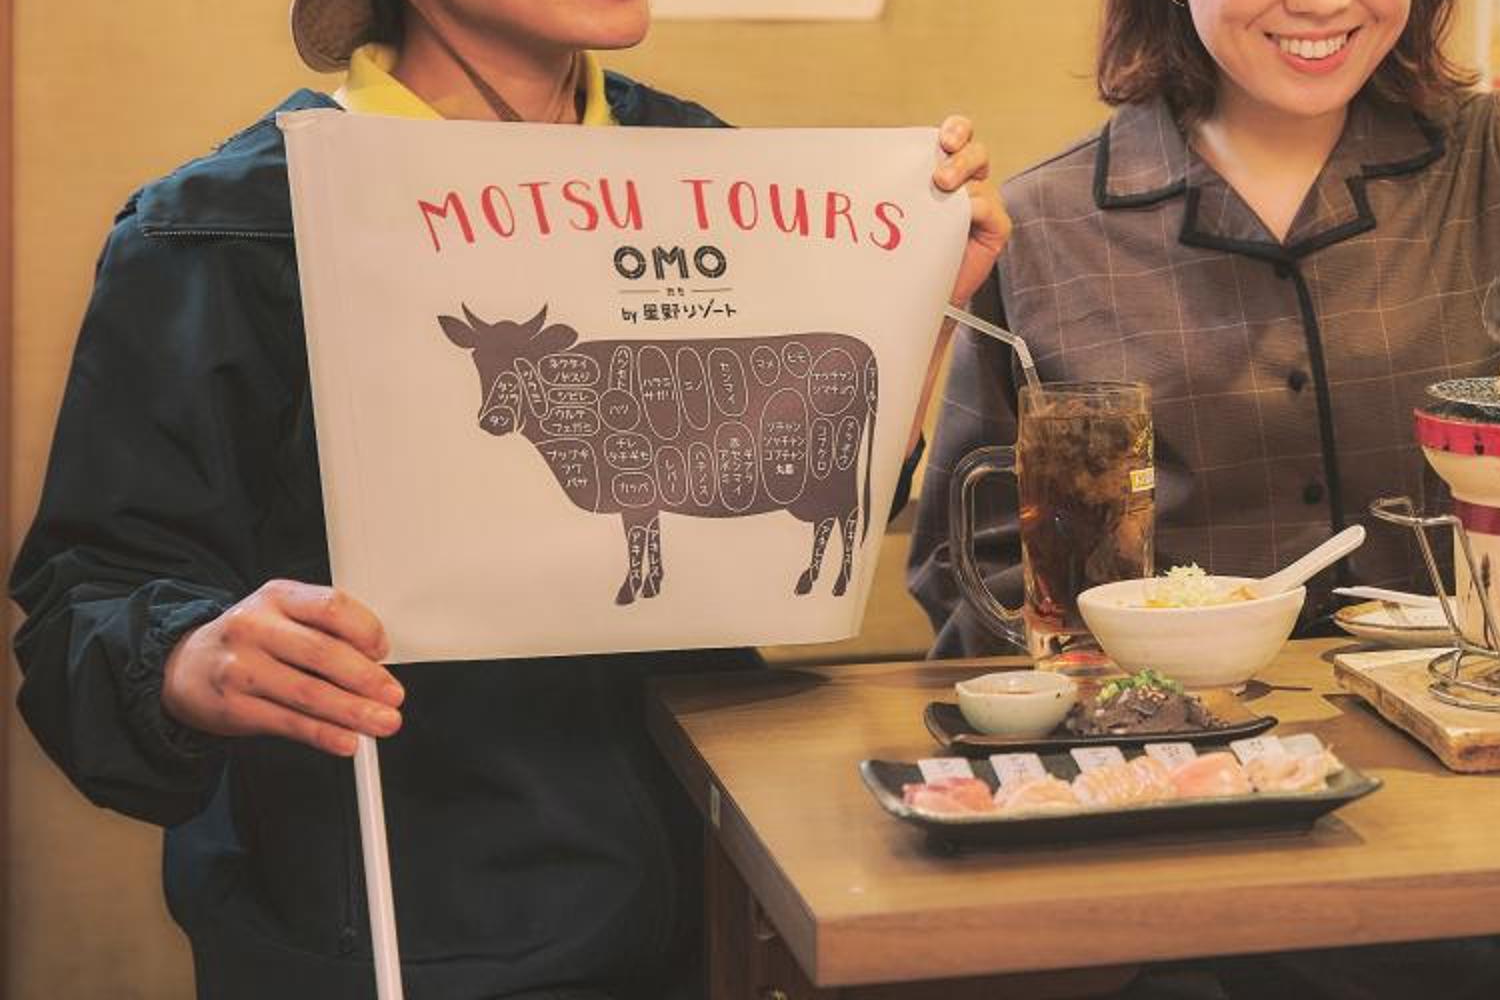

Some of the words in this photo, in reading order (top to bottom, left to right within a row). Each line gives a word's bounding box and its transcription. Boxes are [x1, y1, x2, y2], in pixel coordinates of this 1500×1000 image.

[417, 178, 644, 253] MOTSU
[681, 179, 906, 251] TOURS
[613, 245, 728, 280] OMO
[622, 307, 638, 325] by
[643, 298, 738, 321] 星野リゾート
[489, 415, 511, 427] タン
